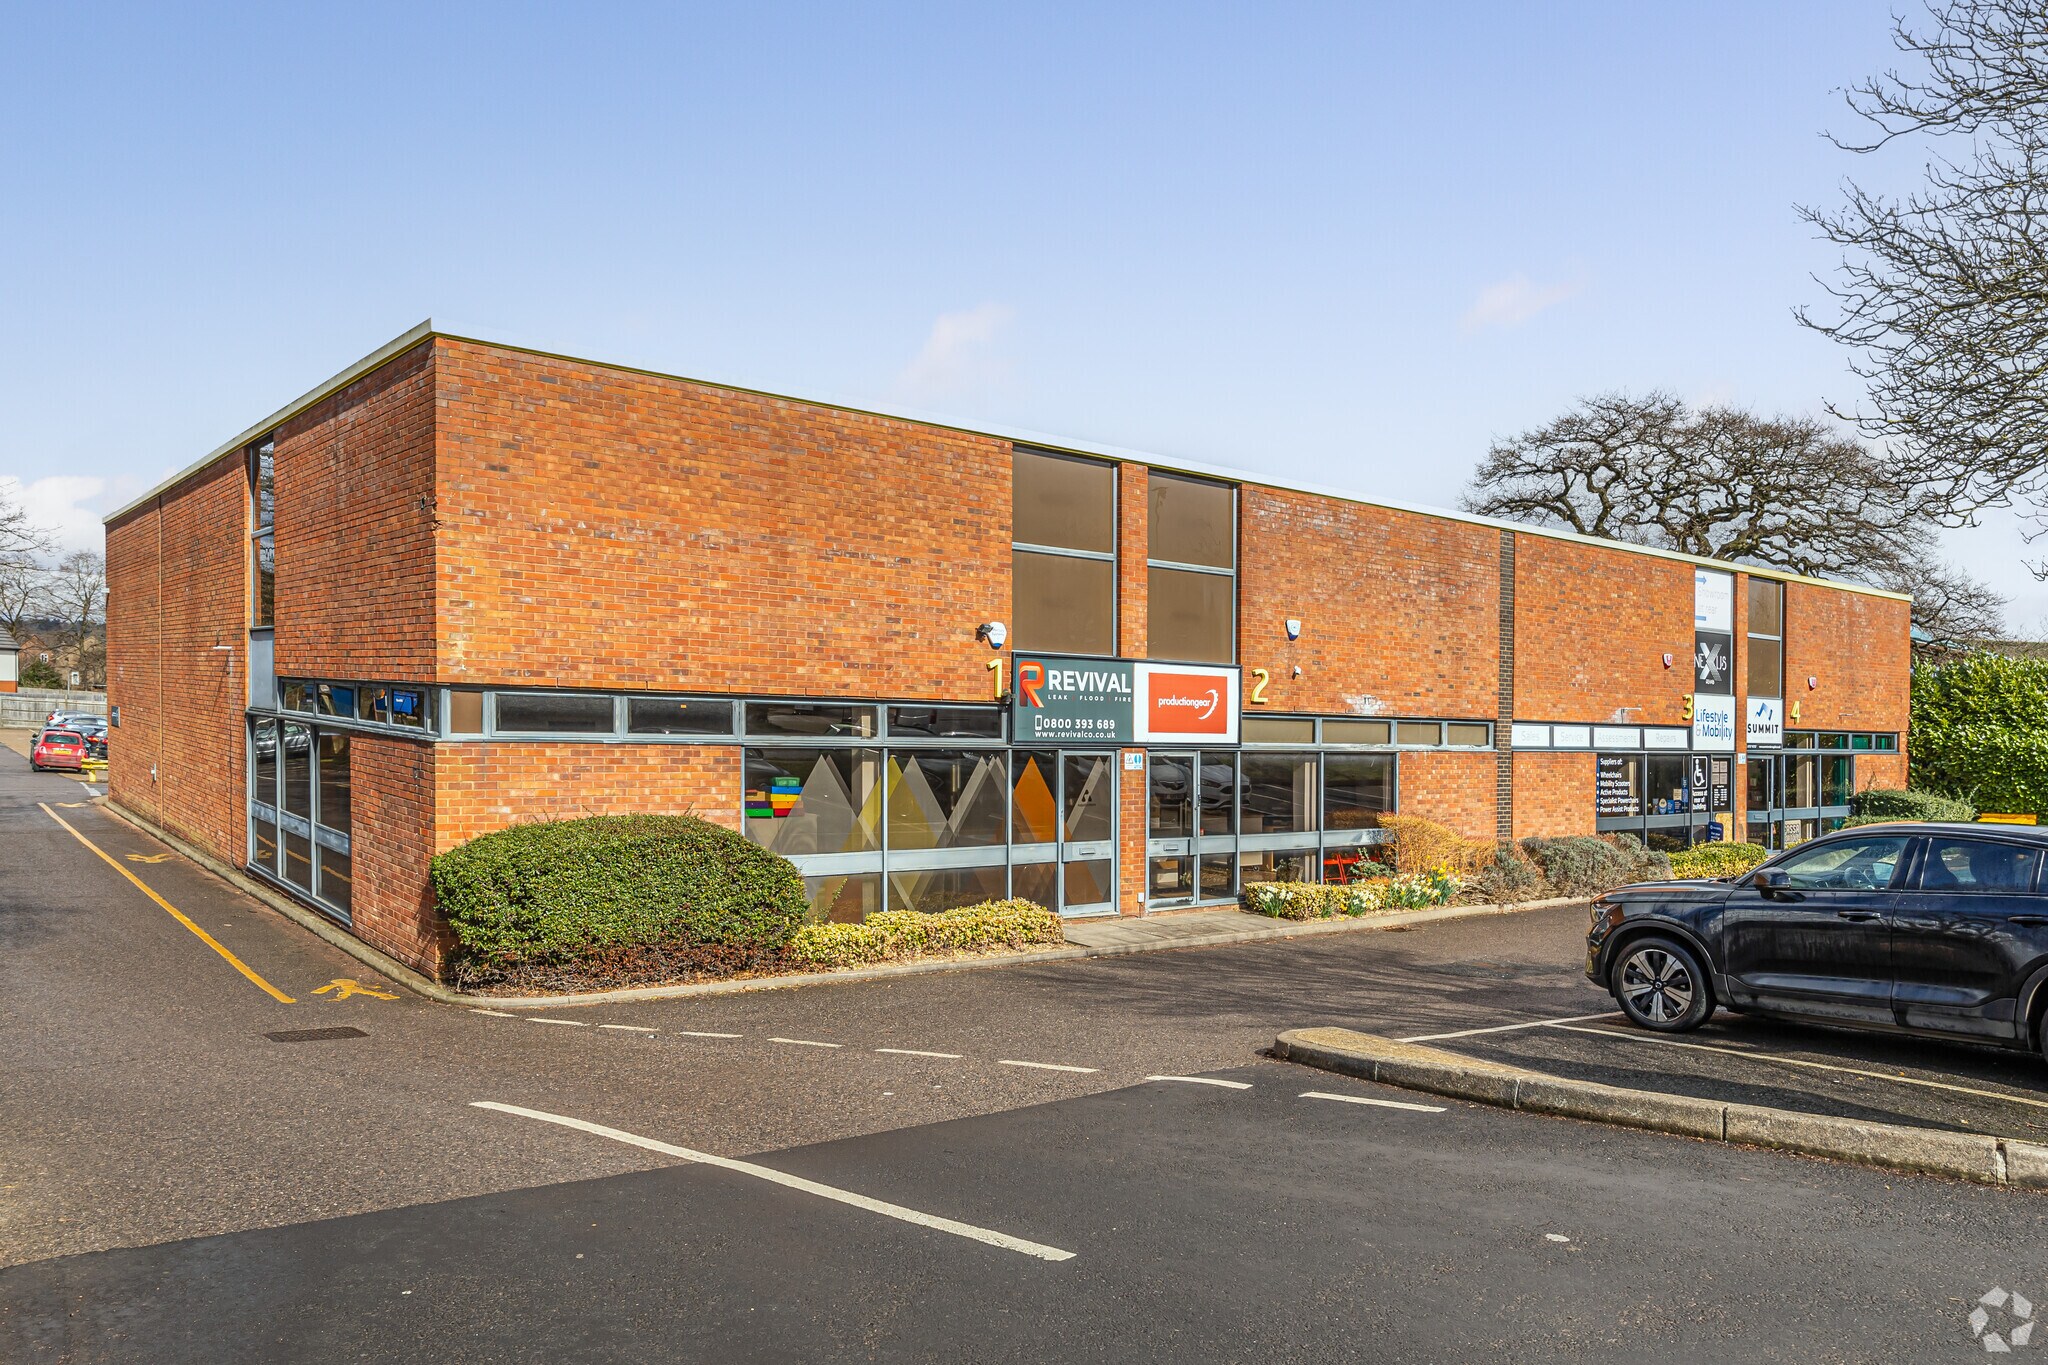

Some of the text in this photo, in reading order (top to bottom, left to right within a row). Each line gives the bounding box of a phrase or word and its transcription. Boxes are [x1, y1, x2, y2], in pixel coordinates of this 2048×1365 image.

[986, 658, 1002, 698] 1
[1048, 669, 1132, 693] REVIVAL
[1251, 668, 1269, 703] 2
[1158, 694, 1211, 709] productiongear
[1682, 694, 1693, 721] 3
[1695, 709, 1728, 724] Lifestyle
[1790, 700, 1801, 725] 4
[1043, 718, 1115, 729] 0800 393 689
[1747, 723, 1779, 734] SUMMIT
[1035, 730, 1116, 738] www.revivalco.co.uk
[1521, 730, 1540, 742] Sales
[1560, 731, 1584, 742] Service
[1702, 723, 1733, 740] Mobility
[1597, 732, 1637, 744] Assessments
[1655, 733, 1677, 745] Repairs
[1600, 758, 1617, 766] Suppliers
[1600, 780, 1615, 788] Mobility
